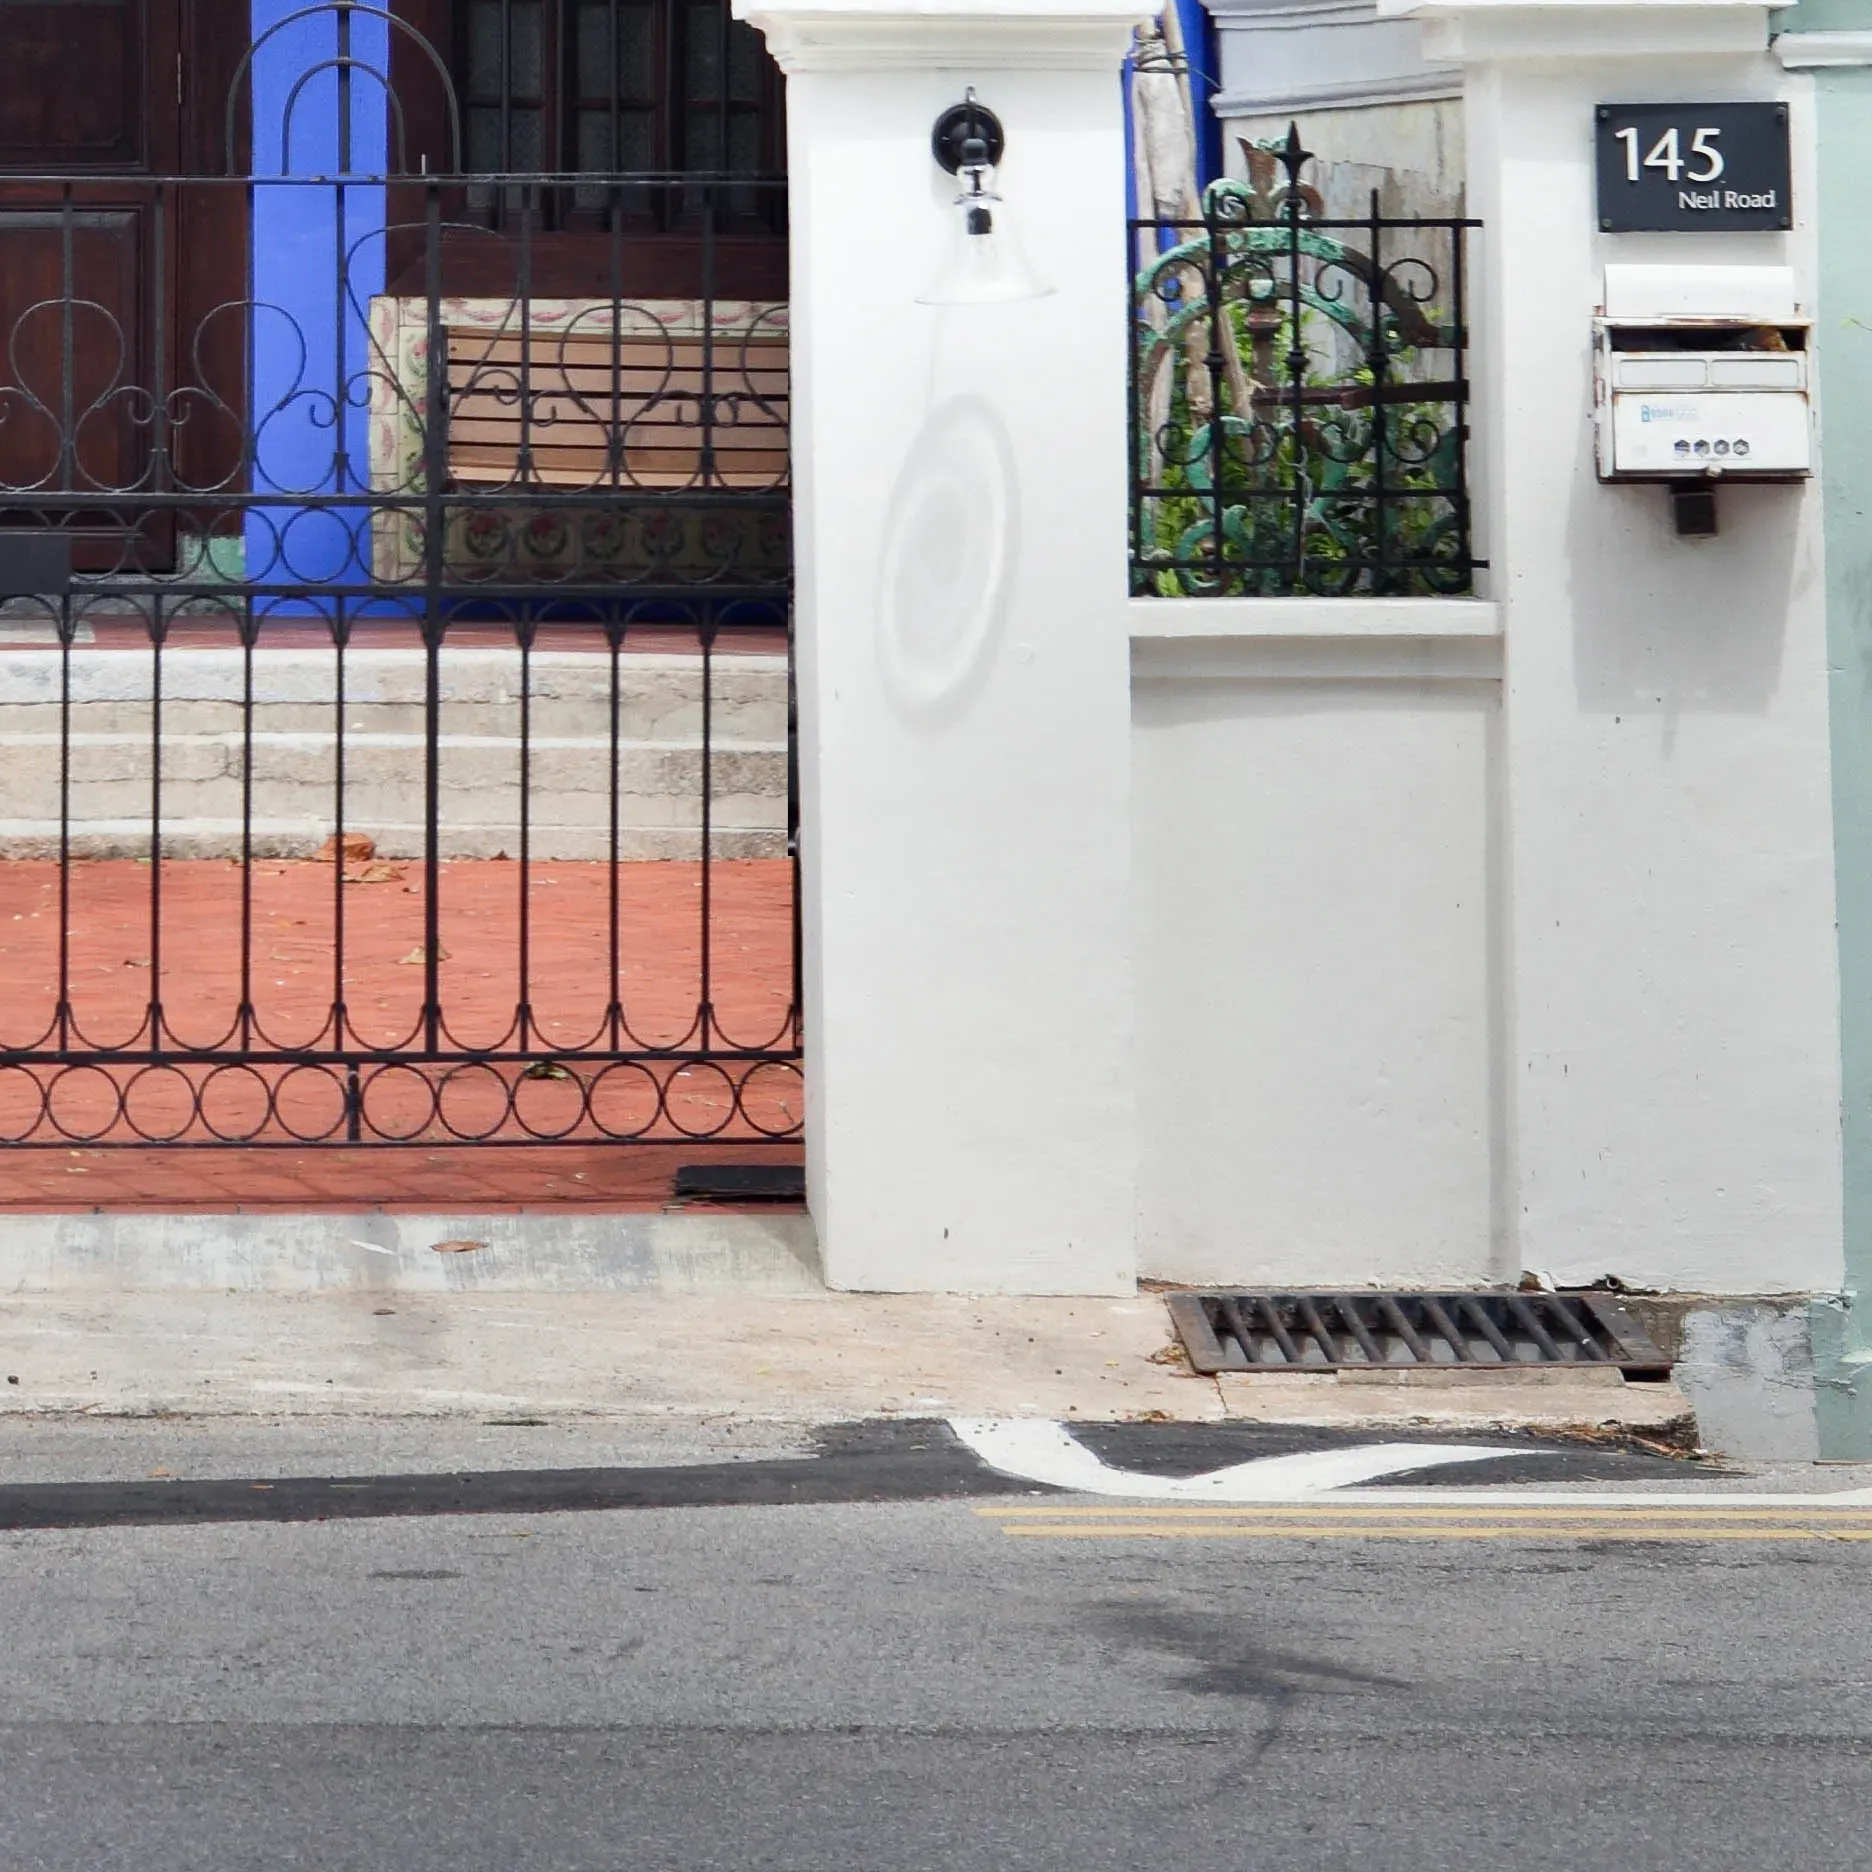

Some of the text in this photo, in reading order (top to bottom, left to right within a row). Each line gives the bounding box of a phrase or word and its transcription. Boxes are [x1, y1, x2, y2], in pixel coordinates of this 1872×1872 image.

[1614, 127, 1725, 183] 145
[1678, 190, 1776, 209] Neil Road
